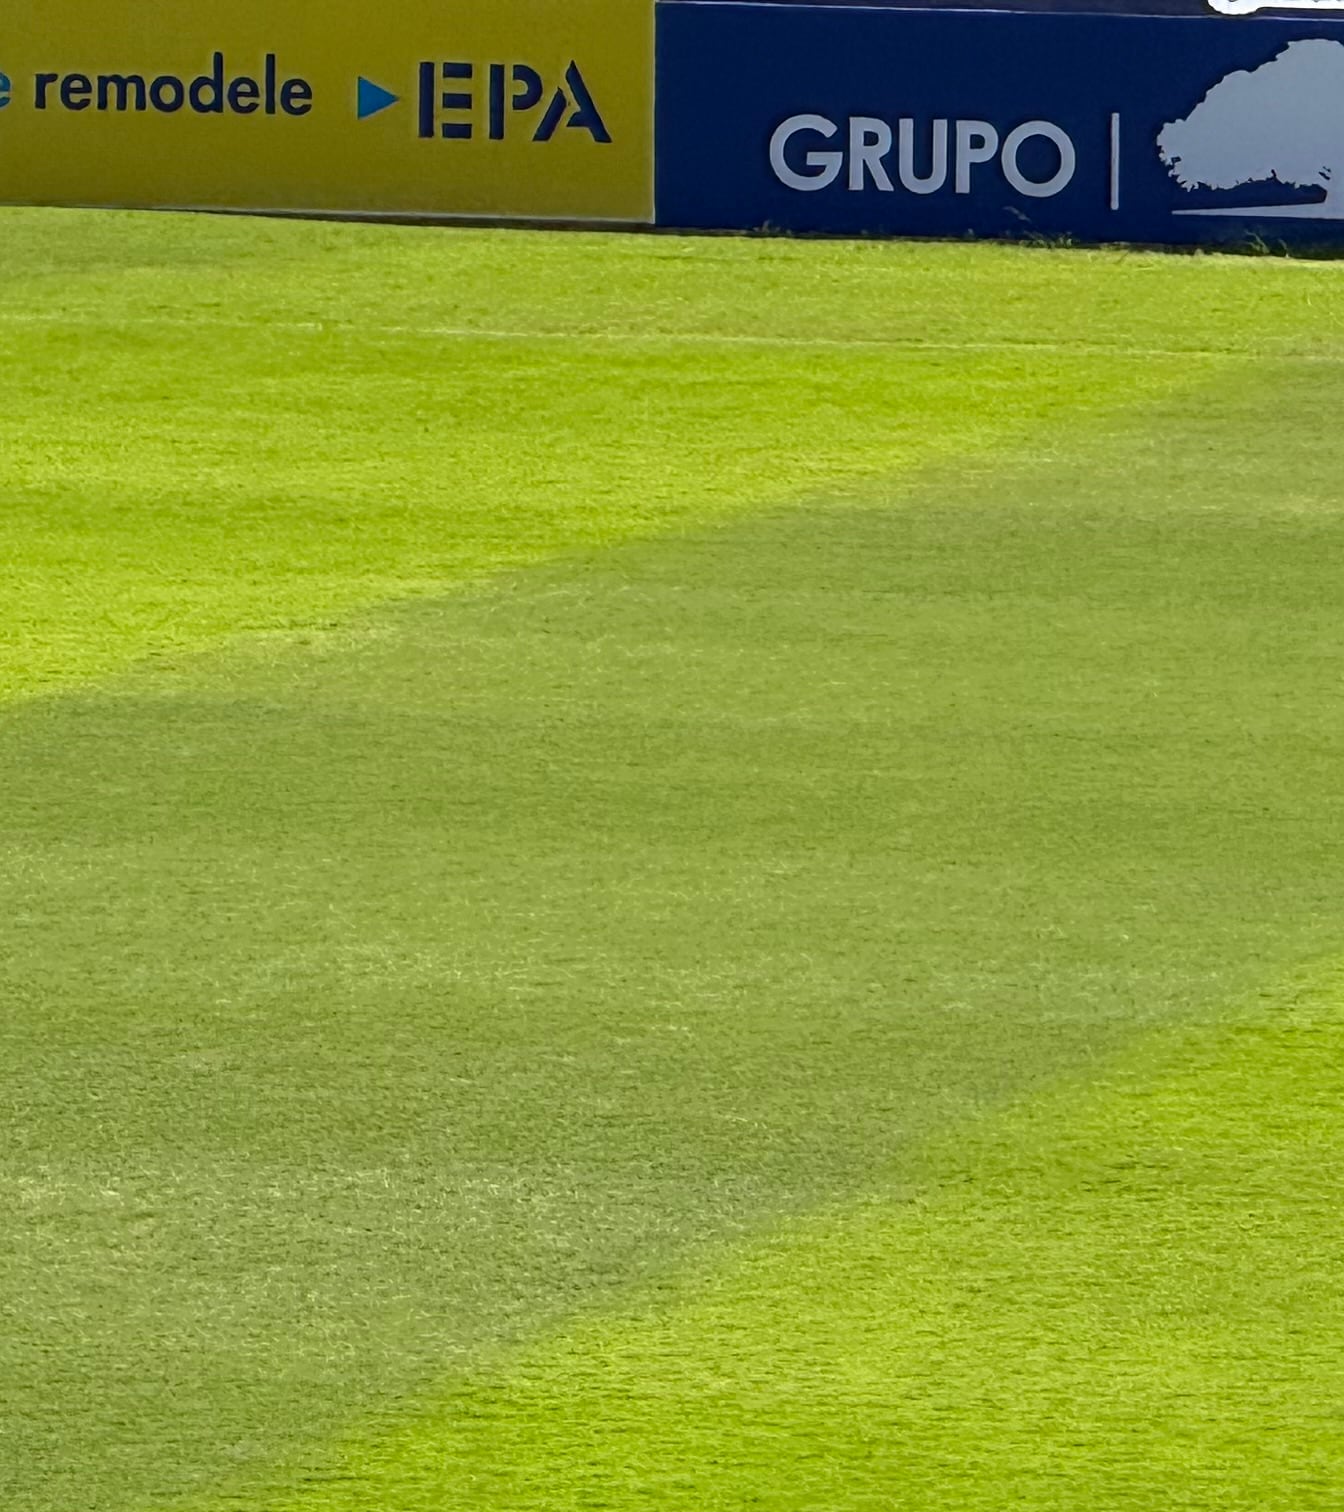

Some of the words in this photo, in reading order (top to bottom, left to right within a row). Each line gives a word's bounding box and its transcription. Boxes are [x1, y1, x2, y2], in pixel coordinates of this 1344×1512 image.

[35, 52, 313, 116] remodele
[418, 60, 612, 144] EPA
[769, 114, 1076, 198] GRUPO
